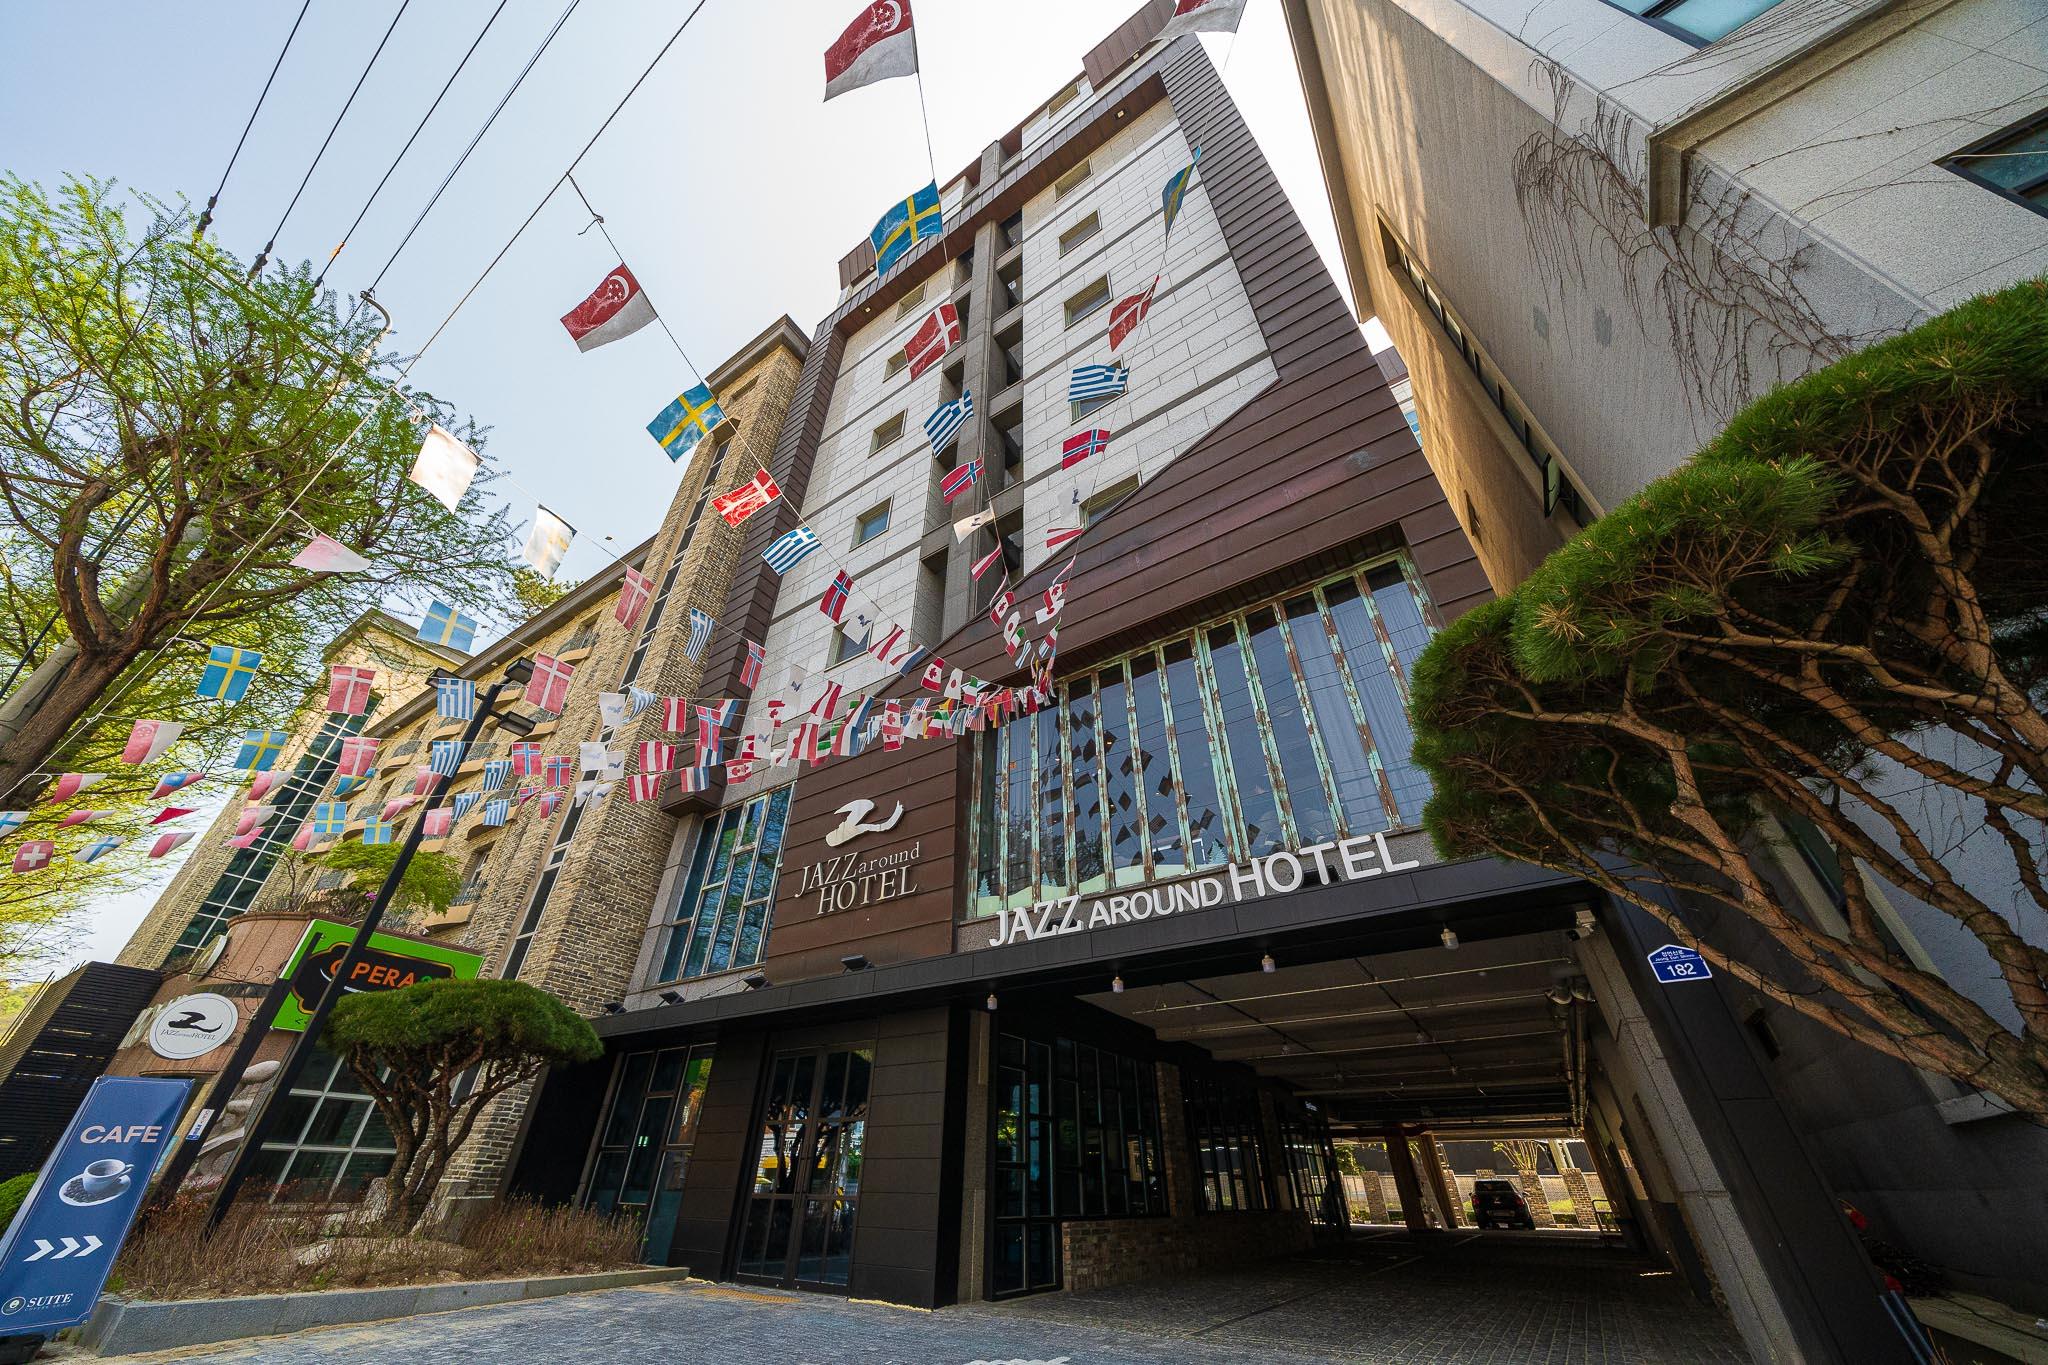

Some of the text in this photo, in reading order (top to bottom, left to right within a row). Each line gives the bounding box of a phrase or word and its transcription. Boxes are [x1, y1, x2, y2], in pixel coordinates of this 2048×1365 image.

[794, 841, 920, 898] JAZZ around
[817, 865, 918, 915] HOTEL
[989, 832, 1420, 947] JAZZ AROUND HOTEL
[1667, 963, 1697, 977] 182
[80, 1125, 163, 1144] CAFE
[27, 1293, 74, 1308] SUITE
